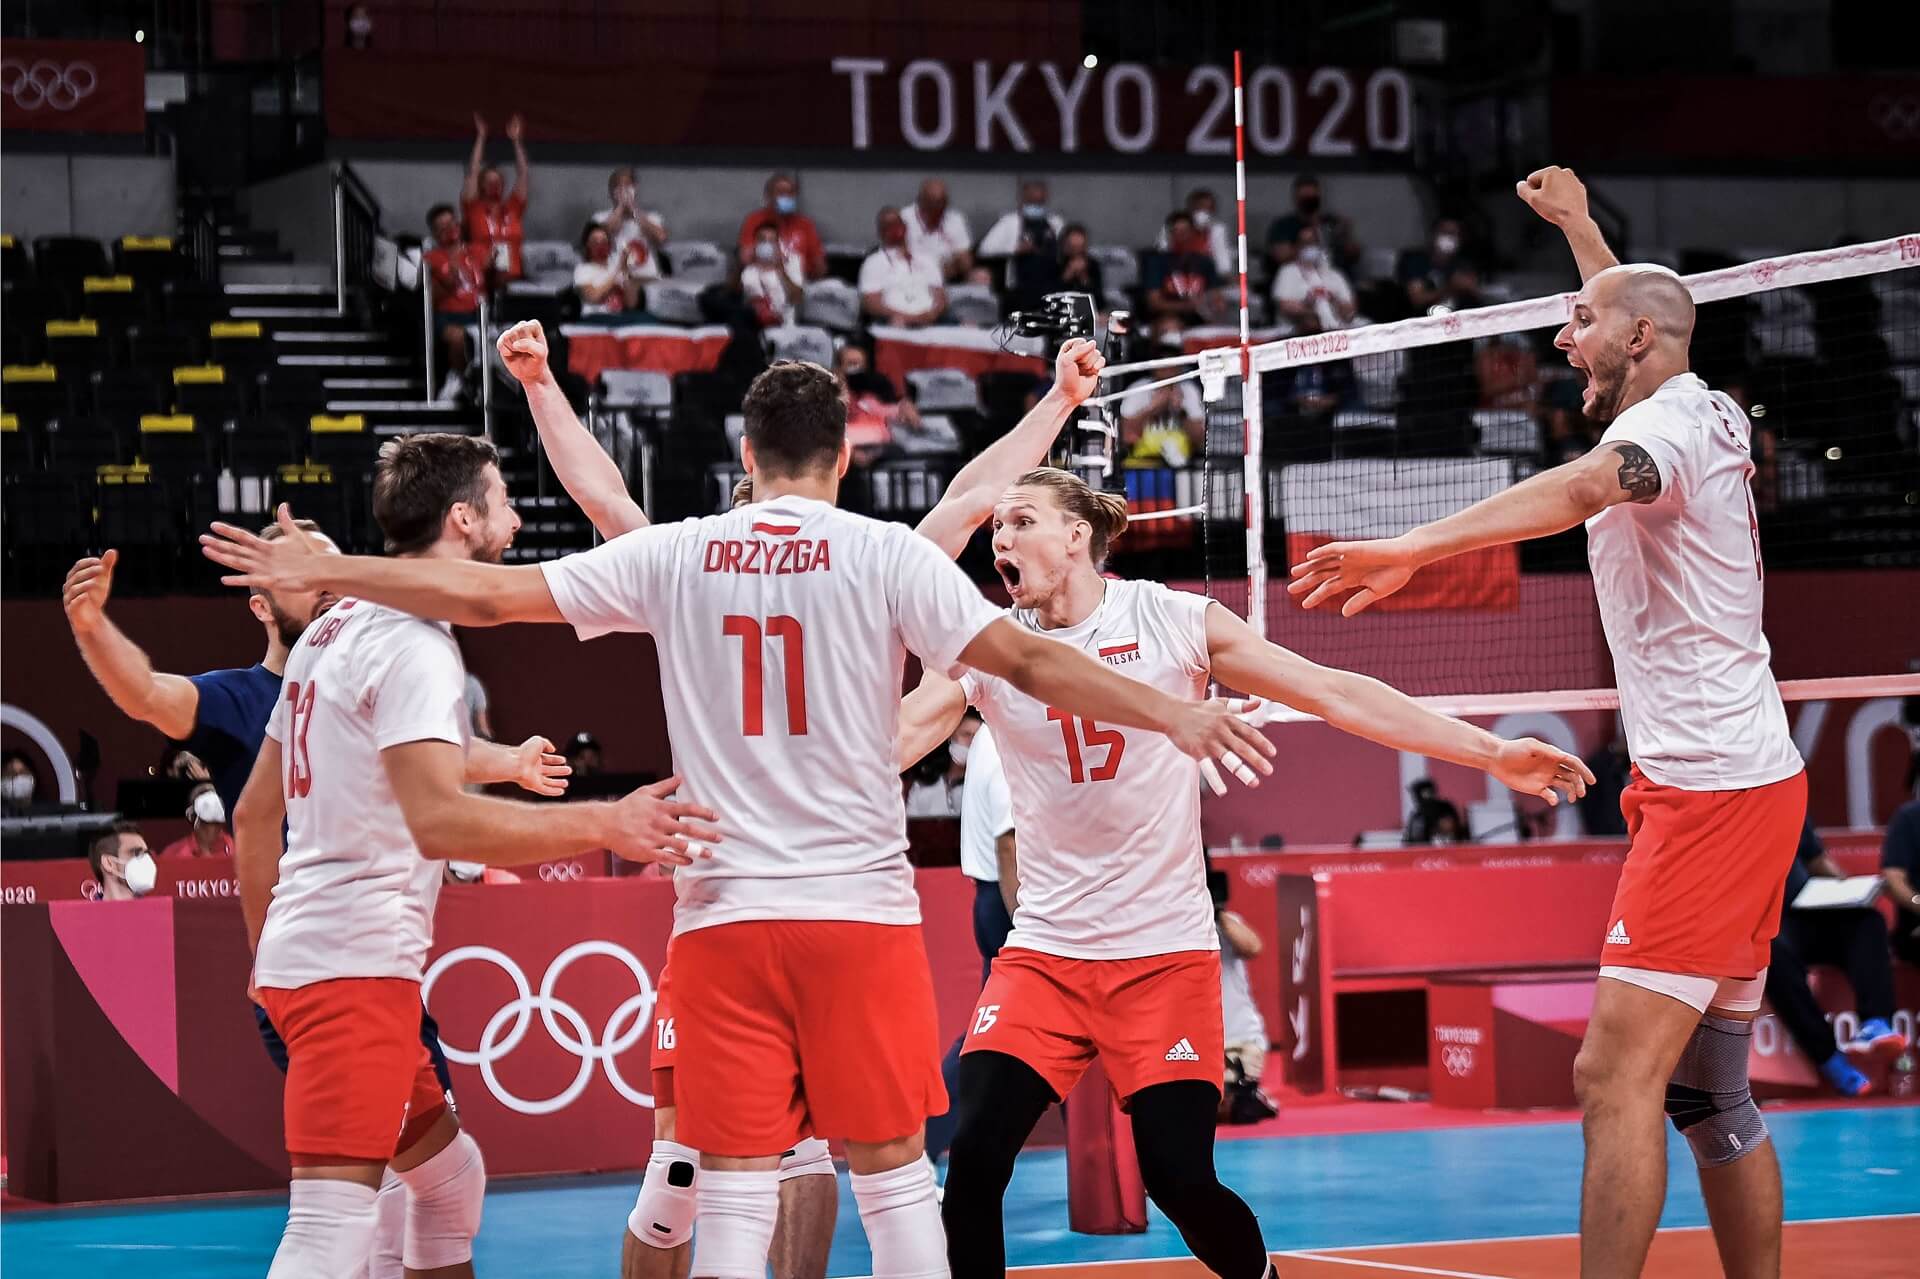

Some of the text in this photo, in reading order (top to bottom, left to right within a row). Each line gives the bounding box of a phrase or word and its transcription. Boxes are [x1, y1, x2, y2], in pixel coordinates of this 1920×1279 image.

[831, 57, 1412, 156] TOKYO 2020
[1286, 332, 1349, 361] TOKYO 2020
[703, 539, 831, 575] DRZYZGA
[722, 614, 808, 736] 11
[1103, 651, 1141, 665] OLSKA
[286, 679, 315, 800] 13
[1046, 703, 1126, 784] 15
[176, 879, 230, 898] TOKYO
[656, 1016, 677, 1050] 16
[973, 1004, 1001, 1036] 15
[1165, 1051, 1200, 1062] adidas
